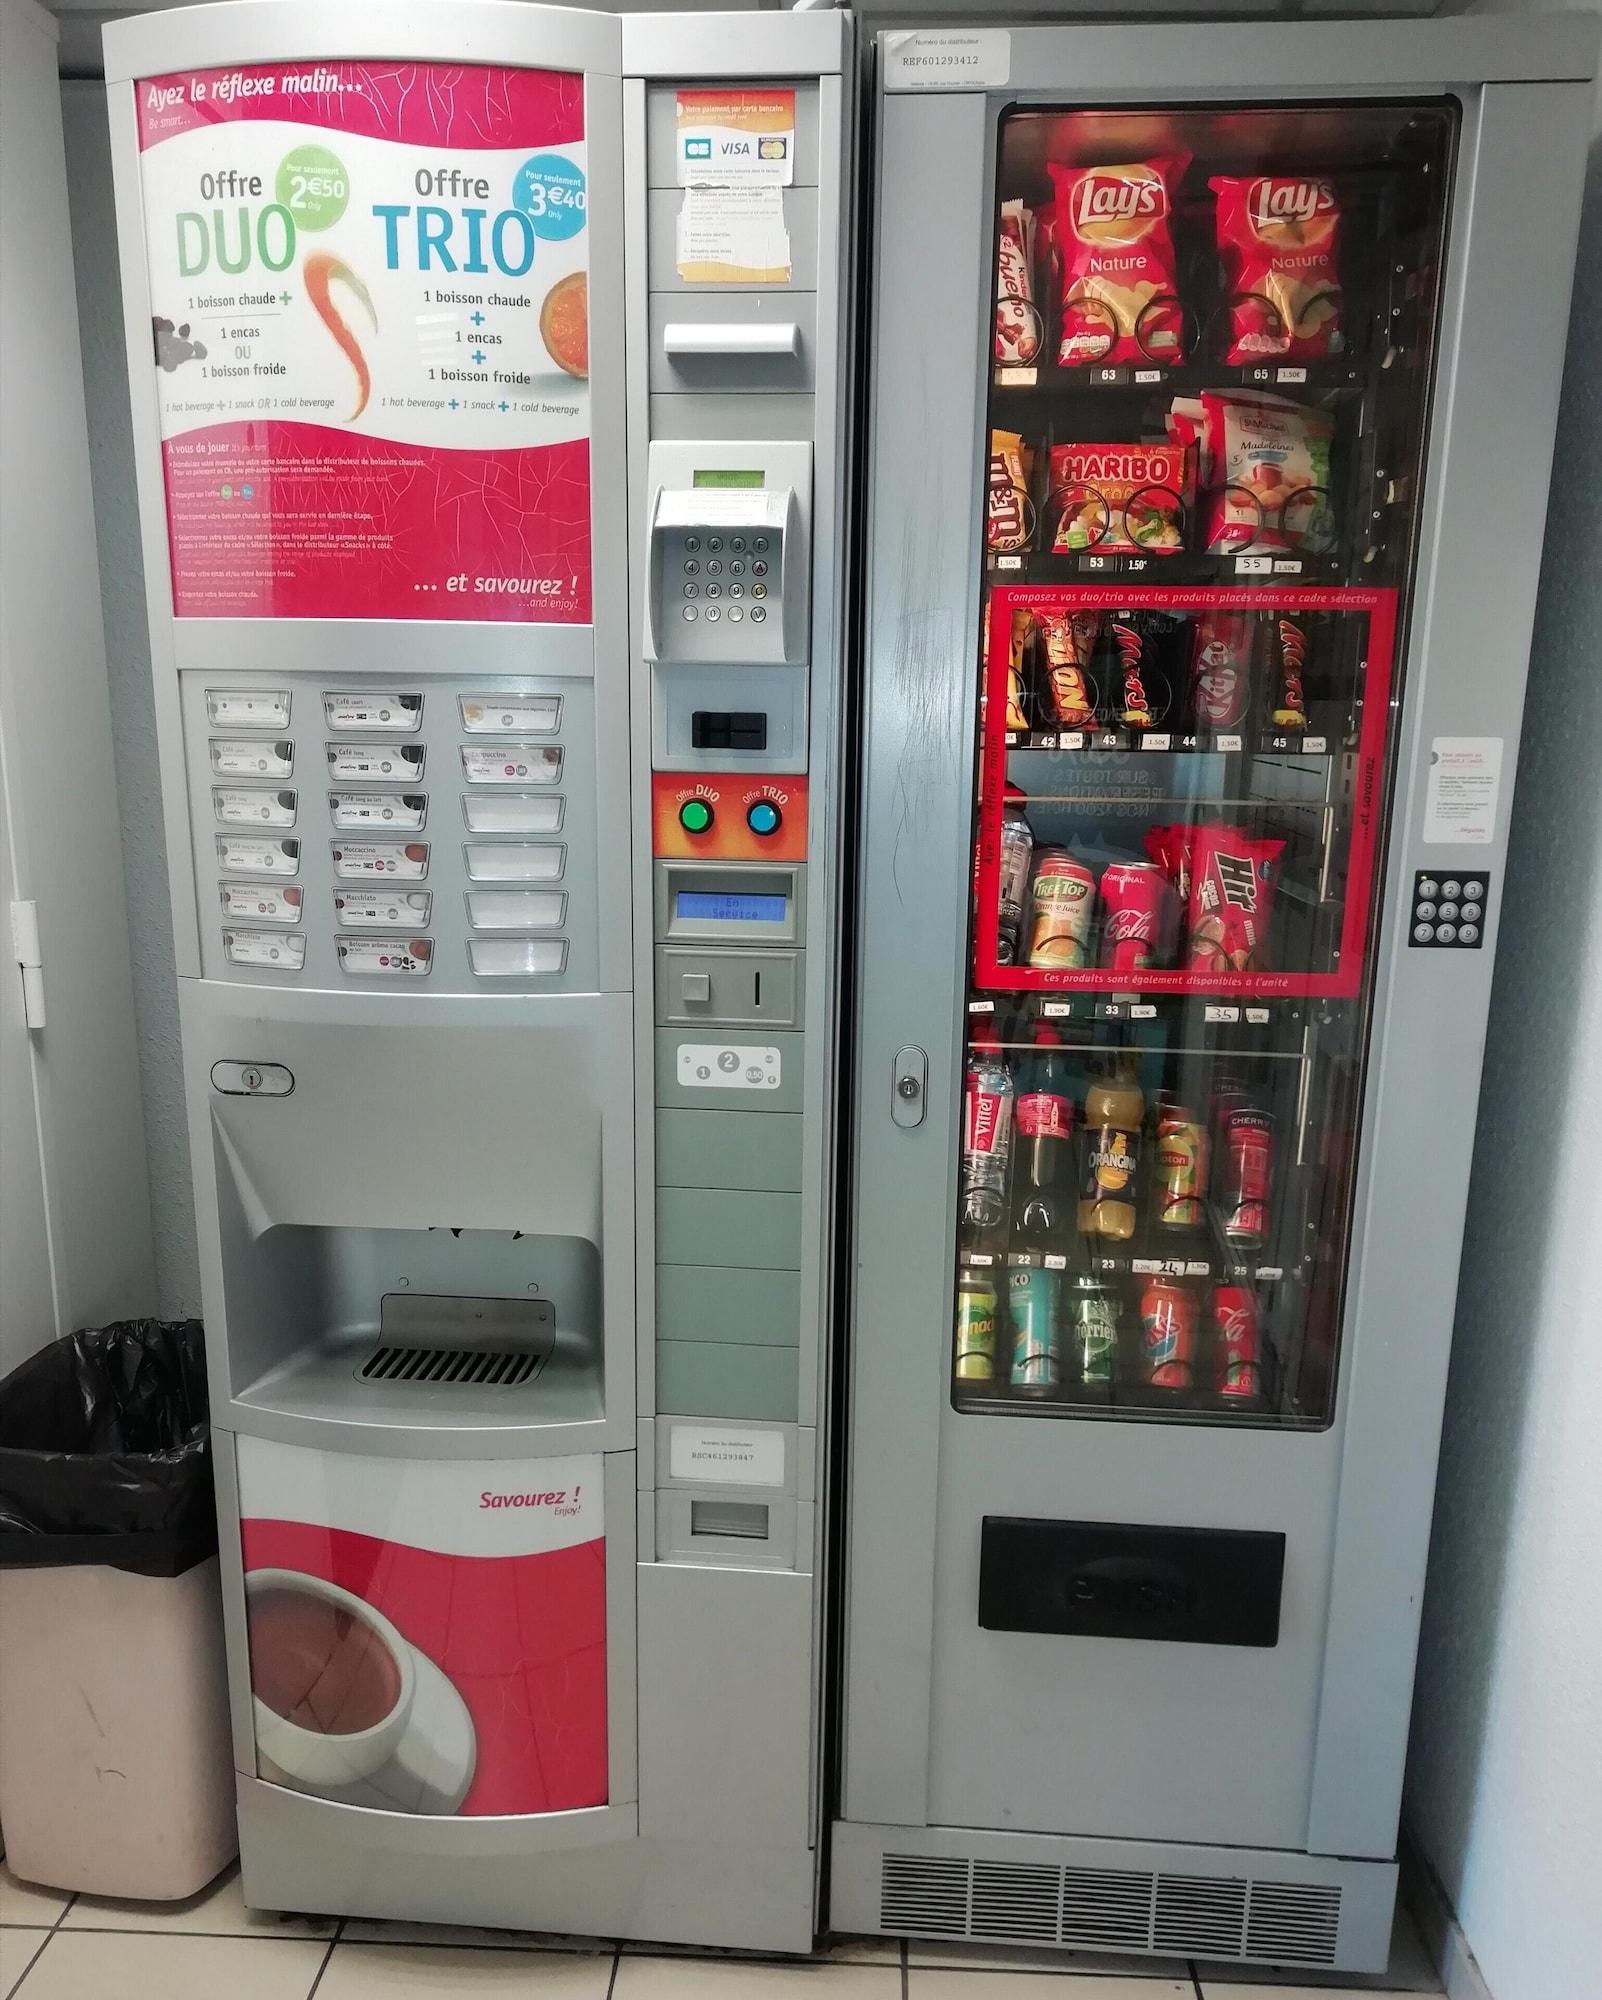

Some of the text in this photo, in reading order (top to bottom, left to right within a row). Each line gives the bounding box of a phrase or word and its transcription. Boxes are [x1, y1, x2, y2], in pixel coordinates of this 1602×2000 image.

[902, 56, 979, 66] REF601293412
[147, 68, 362, 112] Ayez le réflexe malin...
[721, 142, 750, 155] VISA
[415, 168, 490, 199] Offre
[526, 170, 582, 187] Pour seulement
[200, 170, 262, 201] Offre
[290, 175, 345, 208] 2€50
[528, 183, 585, 217] 3€40
[548, 210, 563, 221] Only
[176, 203, 296, 278] DUO
[372, 205, 535, 277] TRIO
[1089, 255, 1147, 273] Nature
[1272, 254, 1328, 270] Nature
[188, 292, 276, 309] 1 boisson chaude
[424, 290, 531, 307] 1 boisson chaude
[221, 327, 260, 339] 1 encas
[455, 331, 502, 344] 1 encas
[235, 346, 251, 360] OU
[202, 363, 287, 378] 1 boisson froide
[428, 368, 531, 385] 1 boisson froide
[1101, 369, 1116, 380] 63
[1253, 369, 1268, 379] 65
[165, 397, 335, 413] 1 hot beverage 1 snack OR 1 cold beverage
[381, 397, 580, 416] 1 hot beverage 1 snack 1 cold beverage
[176, 444, 193, 454] vous
[196, 442, 205, 453] de
[208, 441, 229, 455] jouer
[1240, 441, 1295, 451] Madeleines
[1063, 455, 1170, 484] HARIBO
[1090, 557, 1104, 568] 53
[1128, 559, 1147, 571] 1.50€
[446, 573, 468, 592] et
[474, 575, 563, 595] savourez
[1008, 591, 1378, 604] Composez vos duo/trio avec les produits placés dans ce cadre sélection
[550, 599, 579, 610] enjoy!
[1048, 645, 1090, 712] LION
[1040, 736, 1055, 747] 42
[1102, 735, 1117, 745] 43
[1182, 736, 1197, 747] 44
[1272, 737, 1287, 748] 45
[991, 734, 999, 767] malin
[676, 784, 721, 802] Offre DUO
[742, 785, 789, 805] Offre TRIO
[1037, 881, 1086, 896] TREE TOP
[1426, 886, 1431, 894] 1
[1448, 886, 1454, 894] 2
[713, 908, 758, 919] Service
[1062, 903, 1080, 914] Juice
[1423, 907, 1473, 916] 4 5 6
[1421, 928, 1471, 937] 7 8 9
[1044, 973, 1289, 988] Ces produits sont également disponibles l'unité
[1105, 1005, 1118, 1015] 33
[1209, 1007, 1232, 1020] 35
[723, 1054, 734, 1068] 2
[1231, 1117, 1271, 1127] CHERRY
[1018, 1255, 1031, 1265] 22
[1102, 1259, 1115, 1269] 23
[1234, 1266, 1247, 1276] 25
[479, 1489, 566, 1510] Savourez
[554, 1504, 582, 1517] Enjoy!
